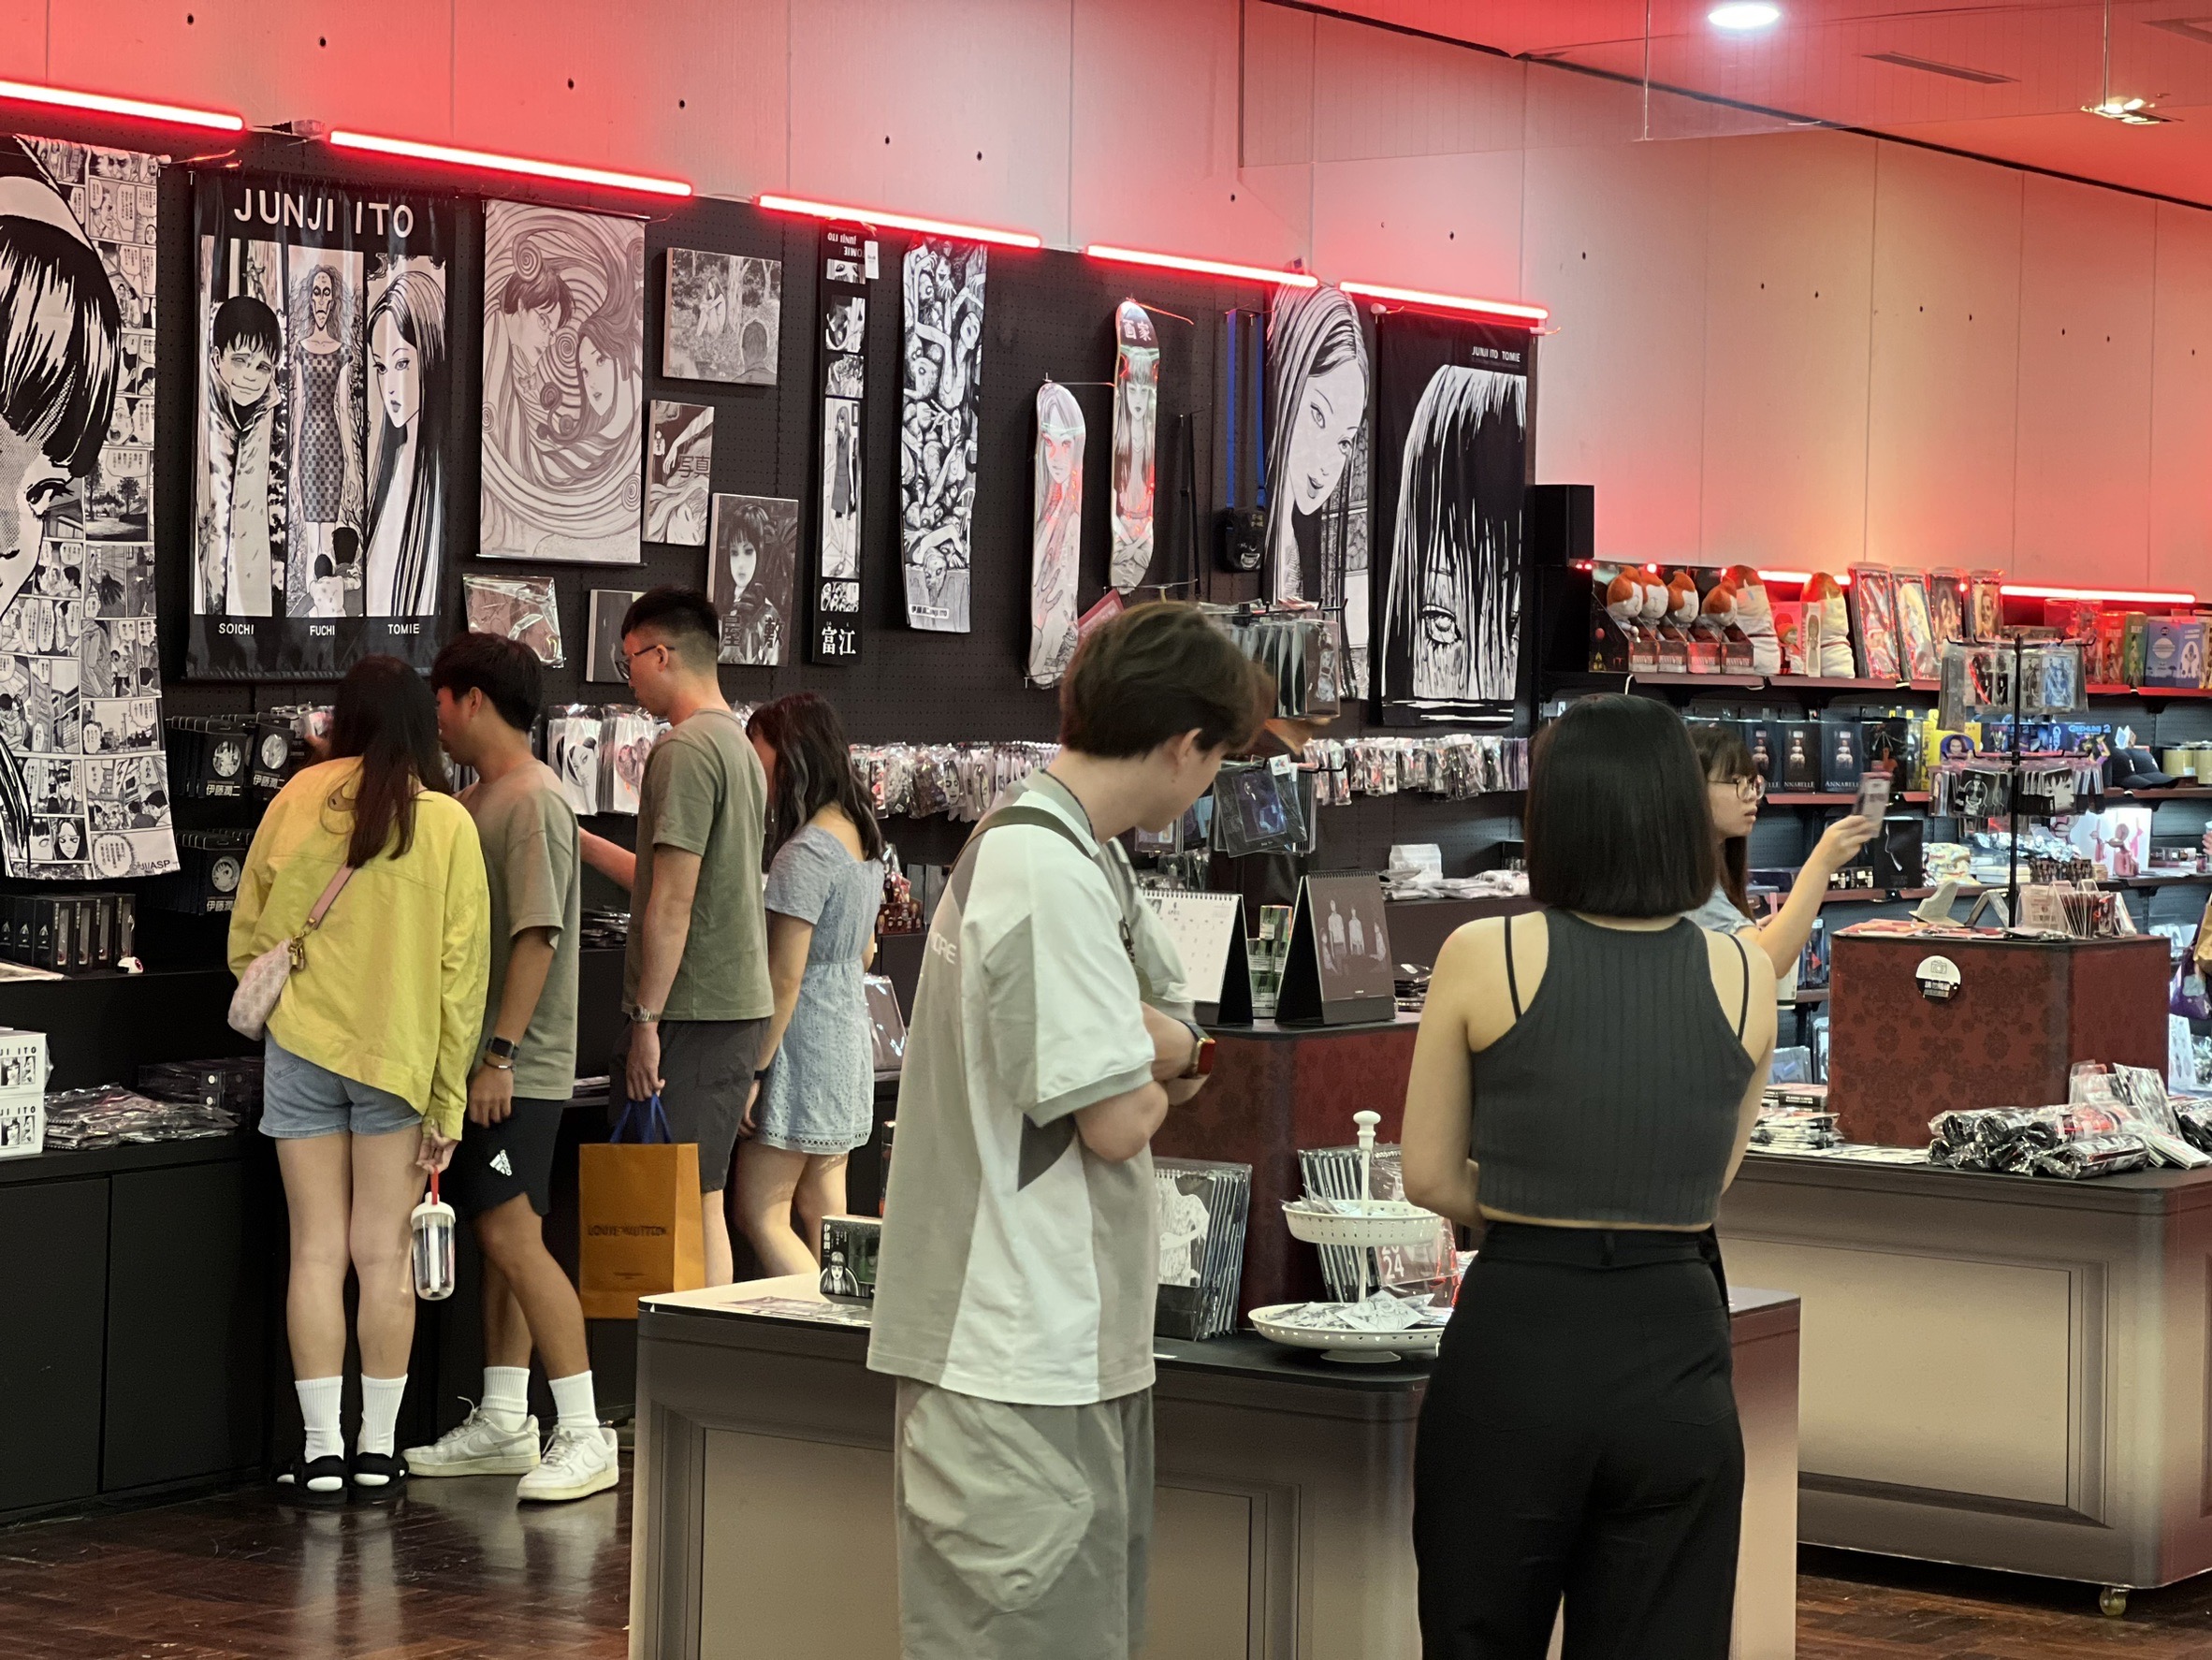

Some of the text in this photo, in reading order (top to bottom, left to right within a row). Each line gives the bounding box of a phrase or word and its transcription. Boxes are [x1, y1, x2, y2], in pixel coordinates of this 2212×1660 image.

[234, 188, 414, 238] JUNJI ITO
[827, 232, 838, 242] ITO
[843, 246, 863, 257] OMIE
[1471, 345, 1521, 363] JUNJI ITO TOMIE
[677, 455, 711, 479] 写真
[218, 622, 255, 635] SOICHI
[309, 624, 336, 636] FUCHI
[387, 622, 420, 634] TOMIE
[822, 626, 857, 656] 富江
[2103, 723, 2111, 734] 2
[1825, 779, 1859, 789] ANNABELL
[17, 1046, 37, 1056] ITO
[17, 1105, 36, 1114] ITO
[1382, 1253, 1404, 1280] 24
